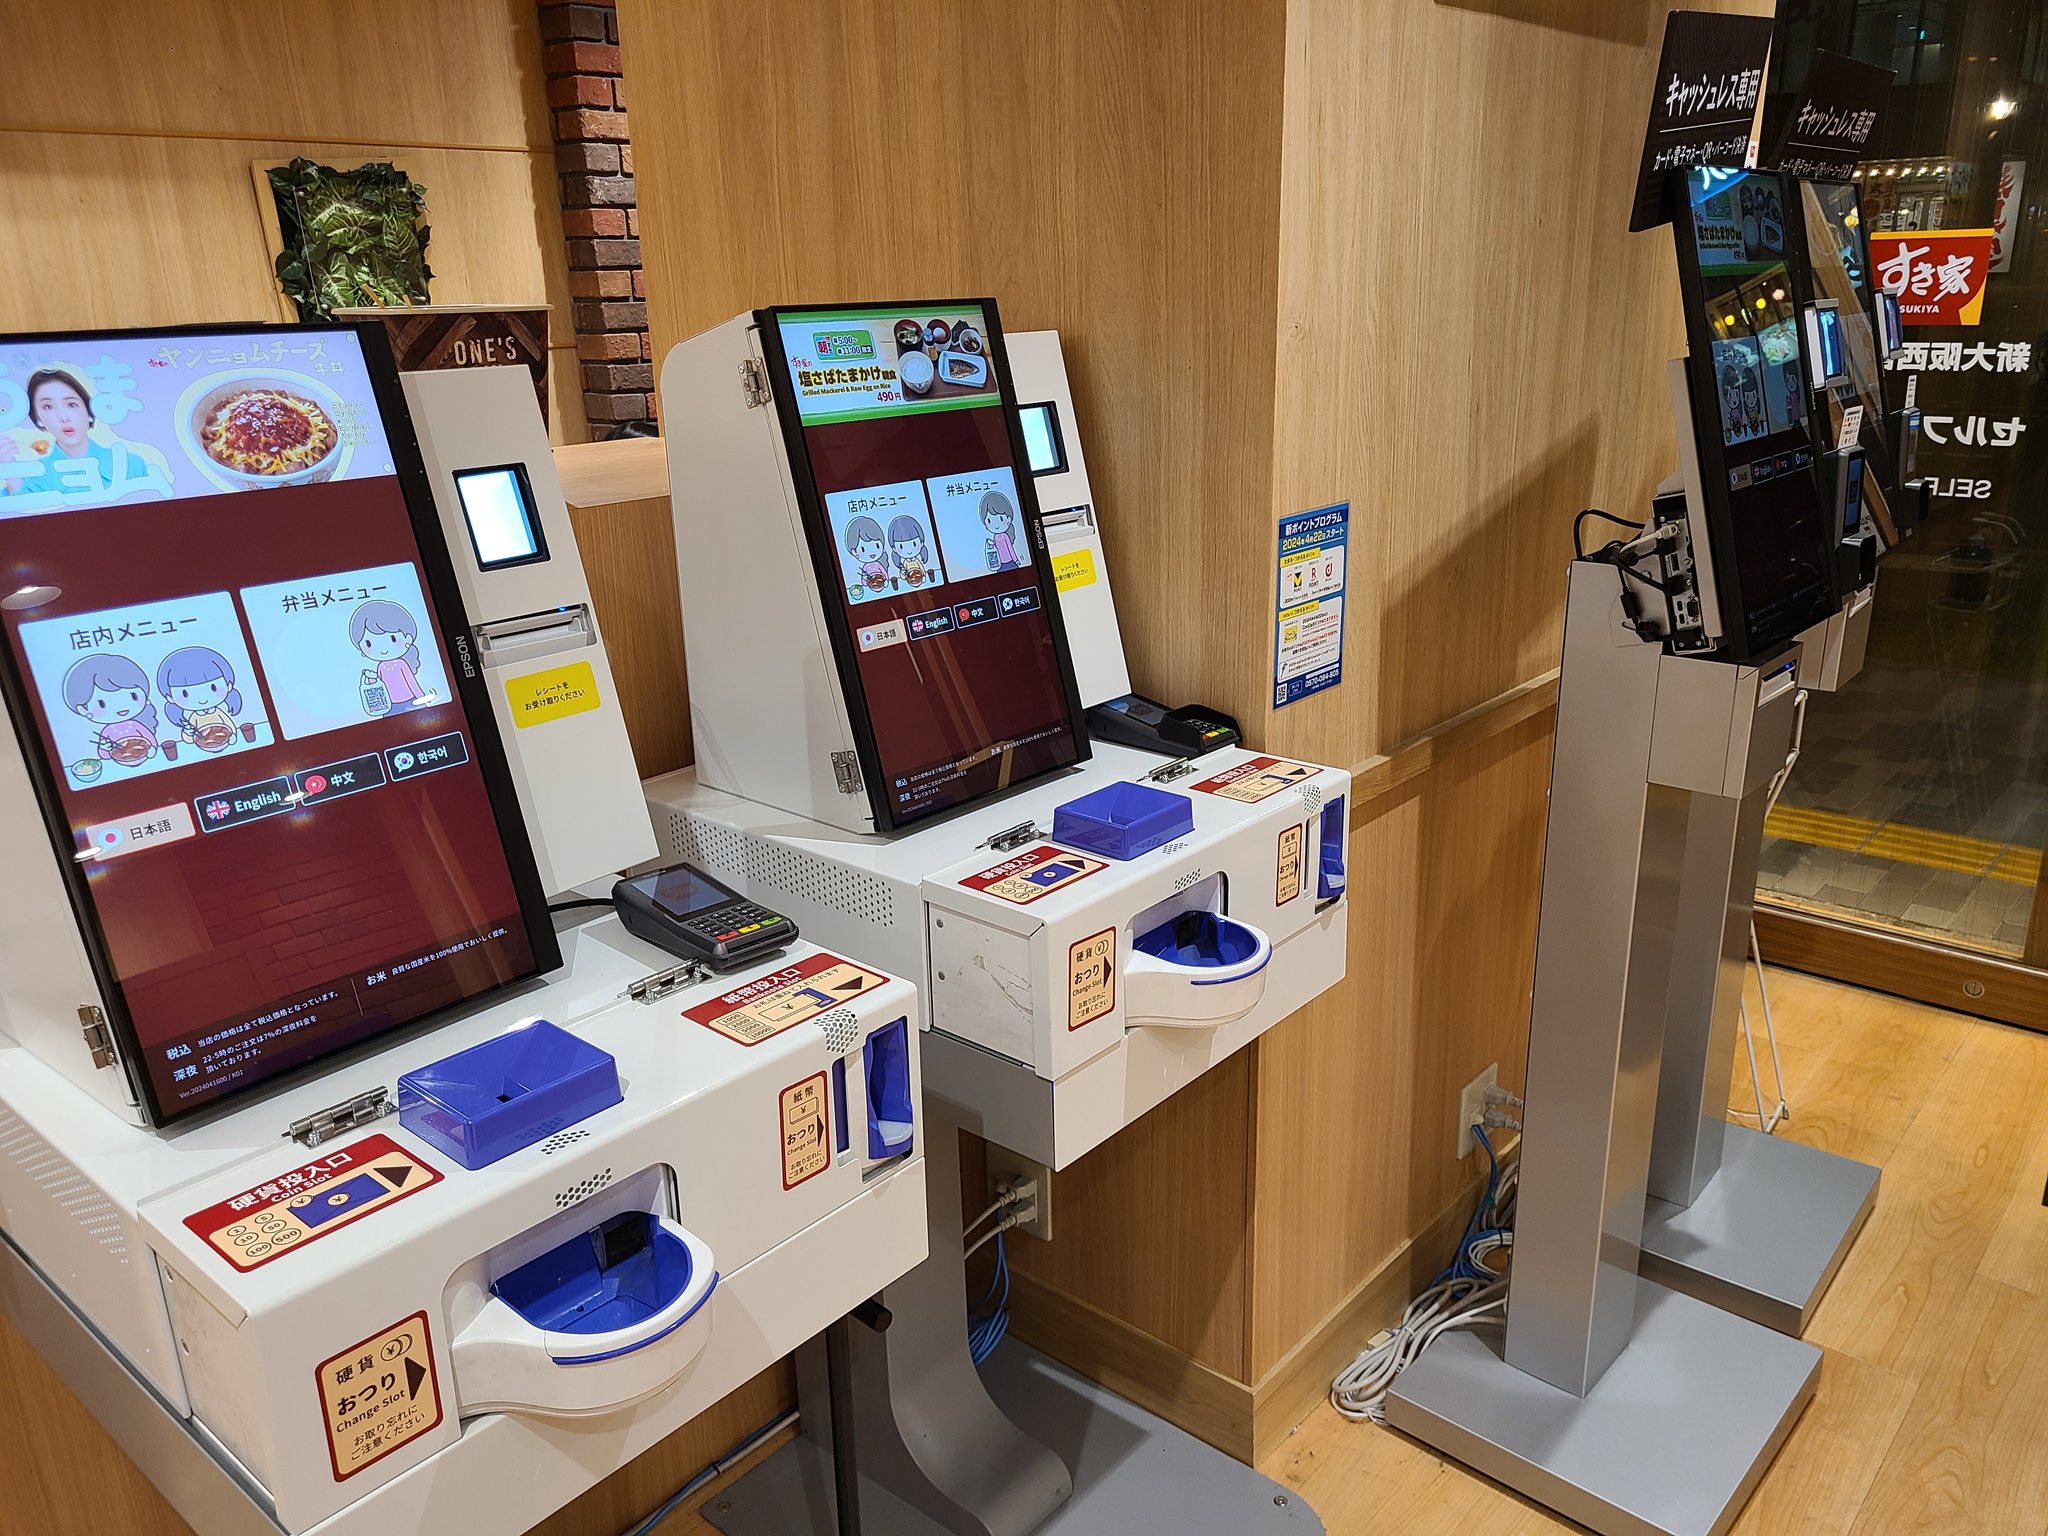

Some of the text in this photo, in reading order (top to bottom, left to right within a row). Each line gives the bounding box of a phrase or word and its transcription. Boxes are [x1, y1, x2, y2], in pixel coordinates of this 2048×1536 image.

[1666, 68, 1761, 117] キャッシュレス専用
[1798, 98, 1877, 144] キャッシュレス専用
[1877, 242, 1974, 302] すき家
[1900, 304, 1940, 314] SUKIYA
[157, 337, 329, 369] ヤンニョムチーズ
[453, 336, 517, 365] ONE'S
[314, 360, 345, 376] 牛丼
[946, 479, 999, 498] 弁当メニュー
[847, 496, 908, 514] 店内メニュー
[1034, 520, 1045, 550] EPSON
[1285, 512, 1343, 536] 新ポイントプログラム
[281, 584, 388, 613] 弁当メニュー
[69, 616, 198, 651] 店内メニュー
[925, 616, 949, 630] English
[455, 635, 476, 678] EPSON
[524, 688, 586, 712] お受け取りください
[535, 681, 570, 697] レシートを
[416, 746, 450, 765] 한국어
[330, 770, 356, 788] 中文
[234, 790, 282, 816] English
[130, 818, 173, 842] 日本語
[366, 970, 388, 986] お米
[1074, 964, 1100, 985] おつり
[1072, 978, 1102, 997] Change Slot
[166, 990, 339, 1060] 税込 当店の価格は全て税込価格となっています。
[172, 1014, 318, 1082] 深夜 22-5時のご注文は7%の深夜料金を
[206, 1047, 262, 1074] 頂いております。
[792, 1085, 814, 1103] 紙幣
[786, 1123, 815, 1146] おつり
[787, 1137, 817, 1156] Change Slot
[788, 1156, 826, 1180] ご注意ください
[790, 1150, 822, 1171] お取り忘れに
[226, 1152, 354, 1212] 硬貨投入口
[271, 1173, 333, 1204] Coin Slot
[240, 1234, 254, 1243] 10
[267, 1222, 281, 1231] 50
[274, 1230, 298, 1243] 500
[249, 1243, 270, 1256] 100
[335, 1354, 375, 1386] 硬貨
[337, 1372, 396, 1416] おつり
[336, 1389, 406, 1433] Change Slot
[351, 1413, 425, 1461] ご注意ください
[354, 1404, 418, 1447] お取り忘れに
